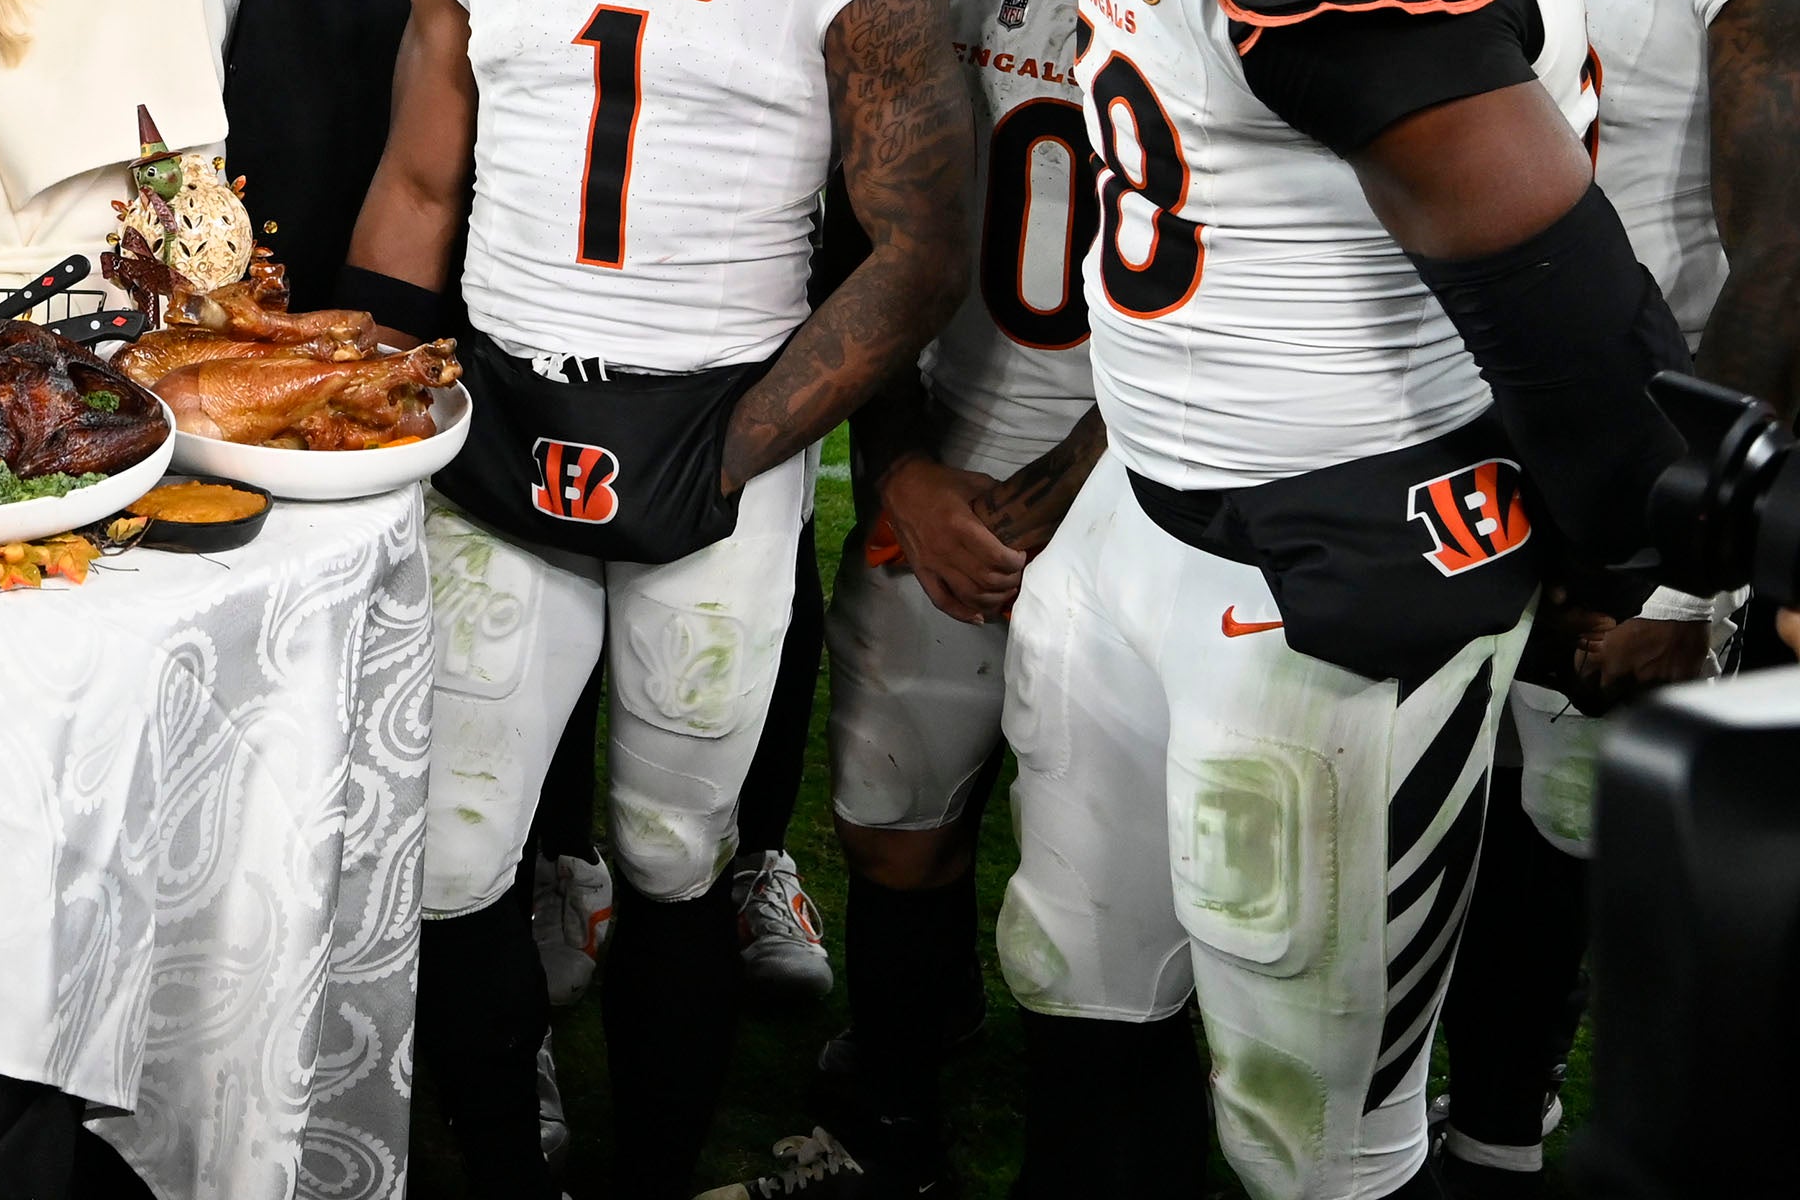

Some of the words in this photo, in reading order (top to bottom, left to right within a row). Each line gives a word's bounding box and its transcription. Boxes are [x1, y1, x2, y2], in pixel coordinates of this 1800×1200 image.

[571, 3, 649, 270] 1
[952, 41, 1080, 87] ENGAL
[1076, 10, 1206, 320] 8
